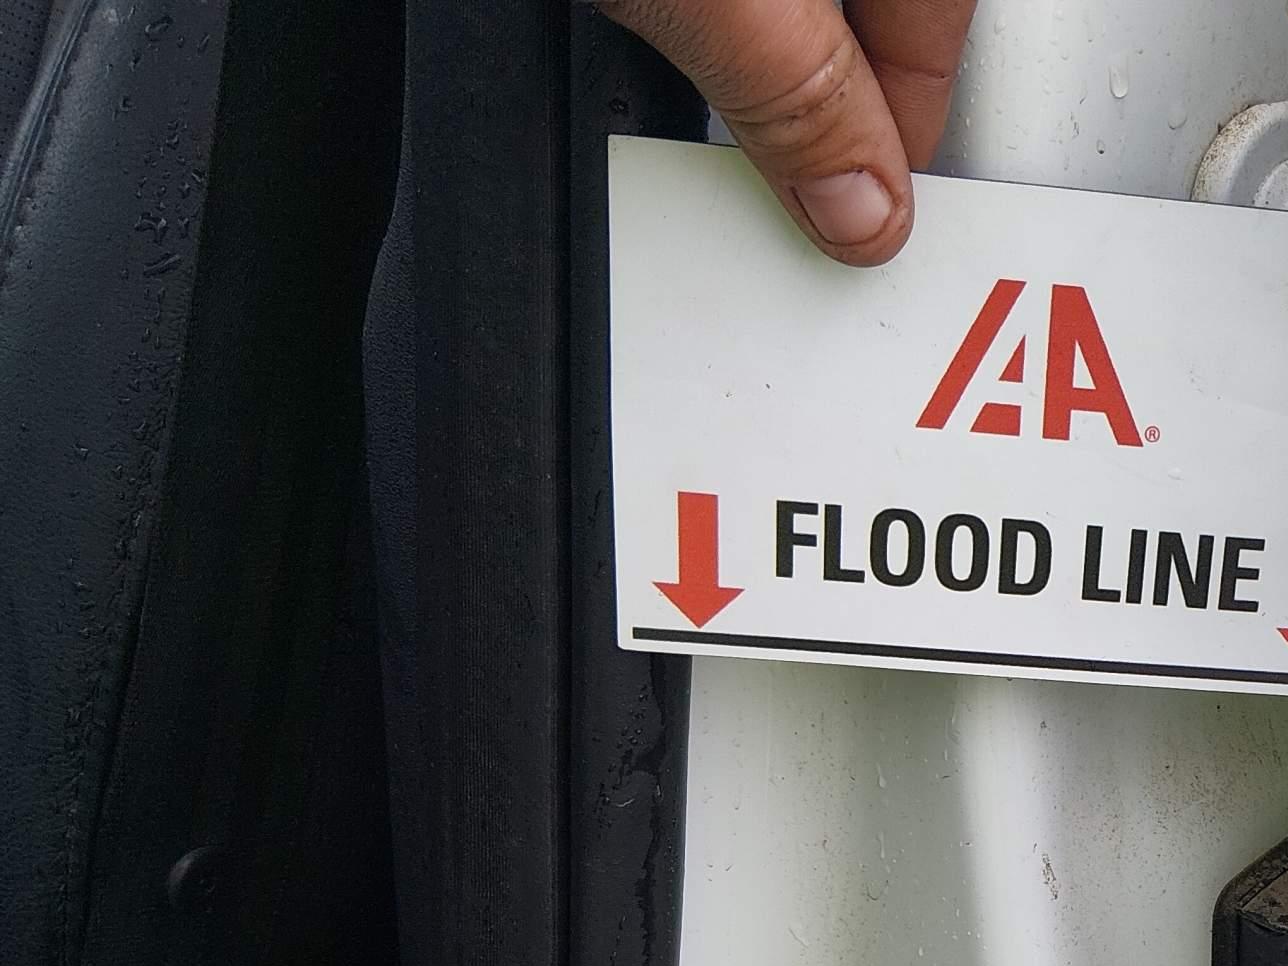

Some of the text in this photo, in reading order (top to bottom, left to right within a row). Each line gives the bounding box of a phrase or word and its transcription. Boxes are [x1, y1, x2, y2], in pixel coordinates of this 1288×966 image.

[915, 278, 1143, 447] IAA
[775, 500, 1266, 612] FLOOD LINE
